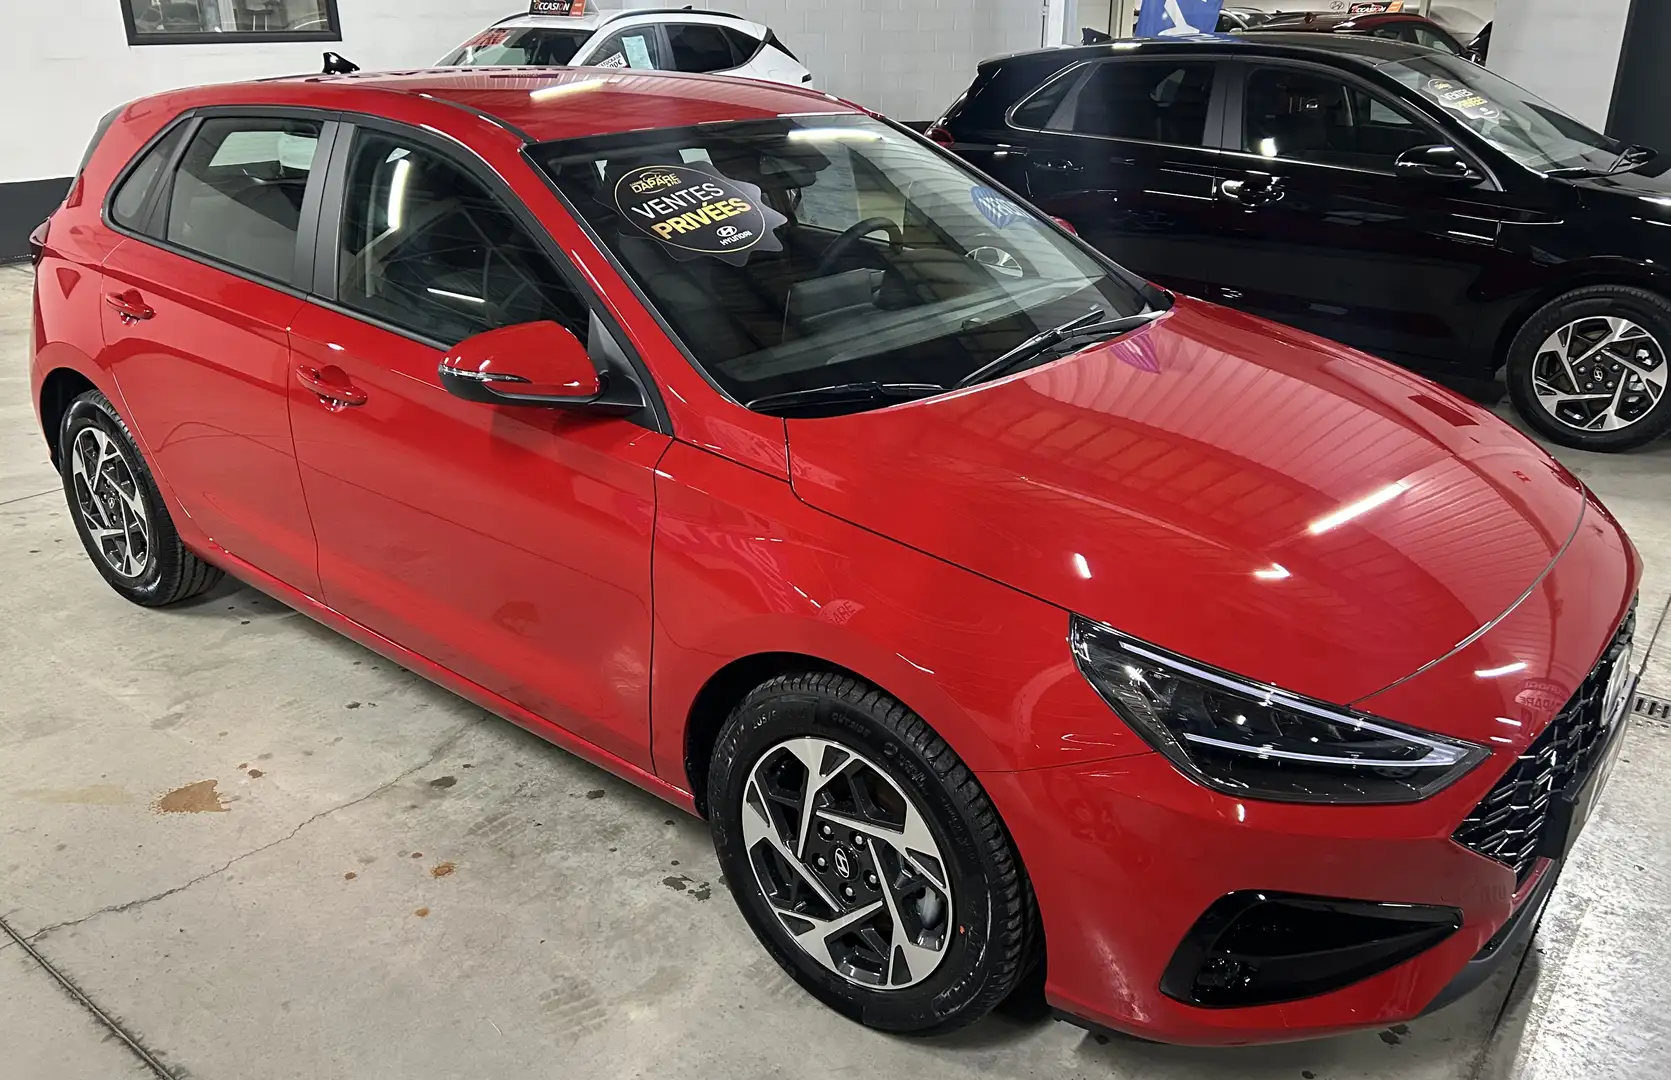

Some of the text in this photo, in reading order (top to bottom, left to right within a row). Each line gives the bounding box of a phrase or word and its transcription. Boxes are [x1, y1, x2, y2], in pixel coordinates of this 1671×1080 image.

[533, 2, 571, 11] OCCASION
[630, 173, 679, 193] DAPARE
[631, 182, 725, 219] VENTES
[651, 197, 752, 240] PRIVÉES
[719, 230, 753, 246] HYUNDAI
